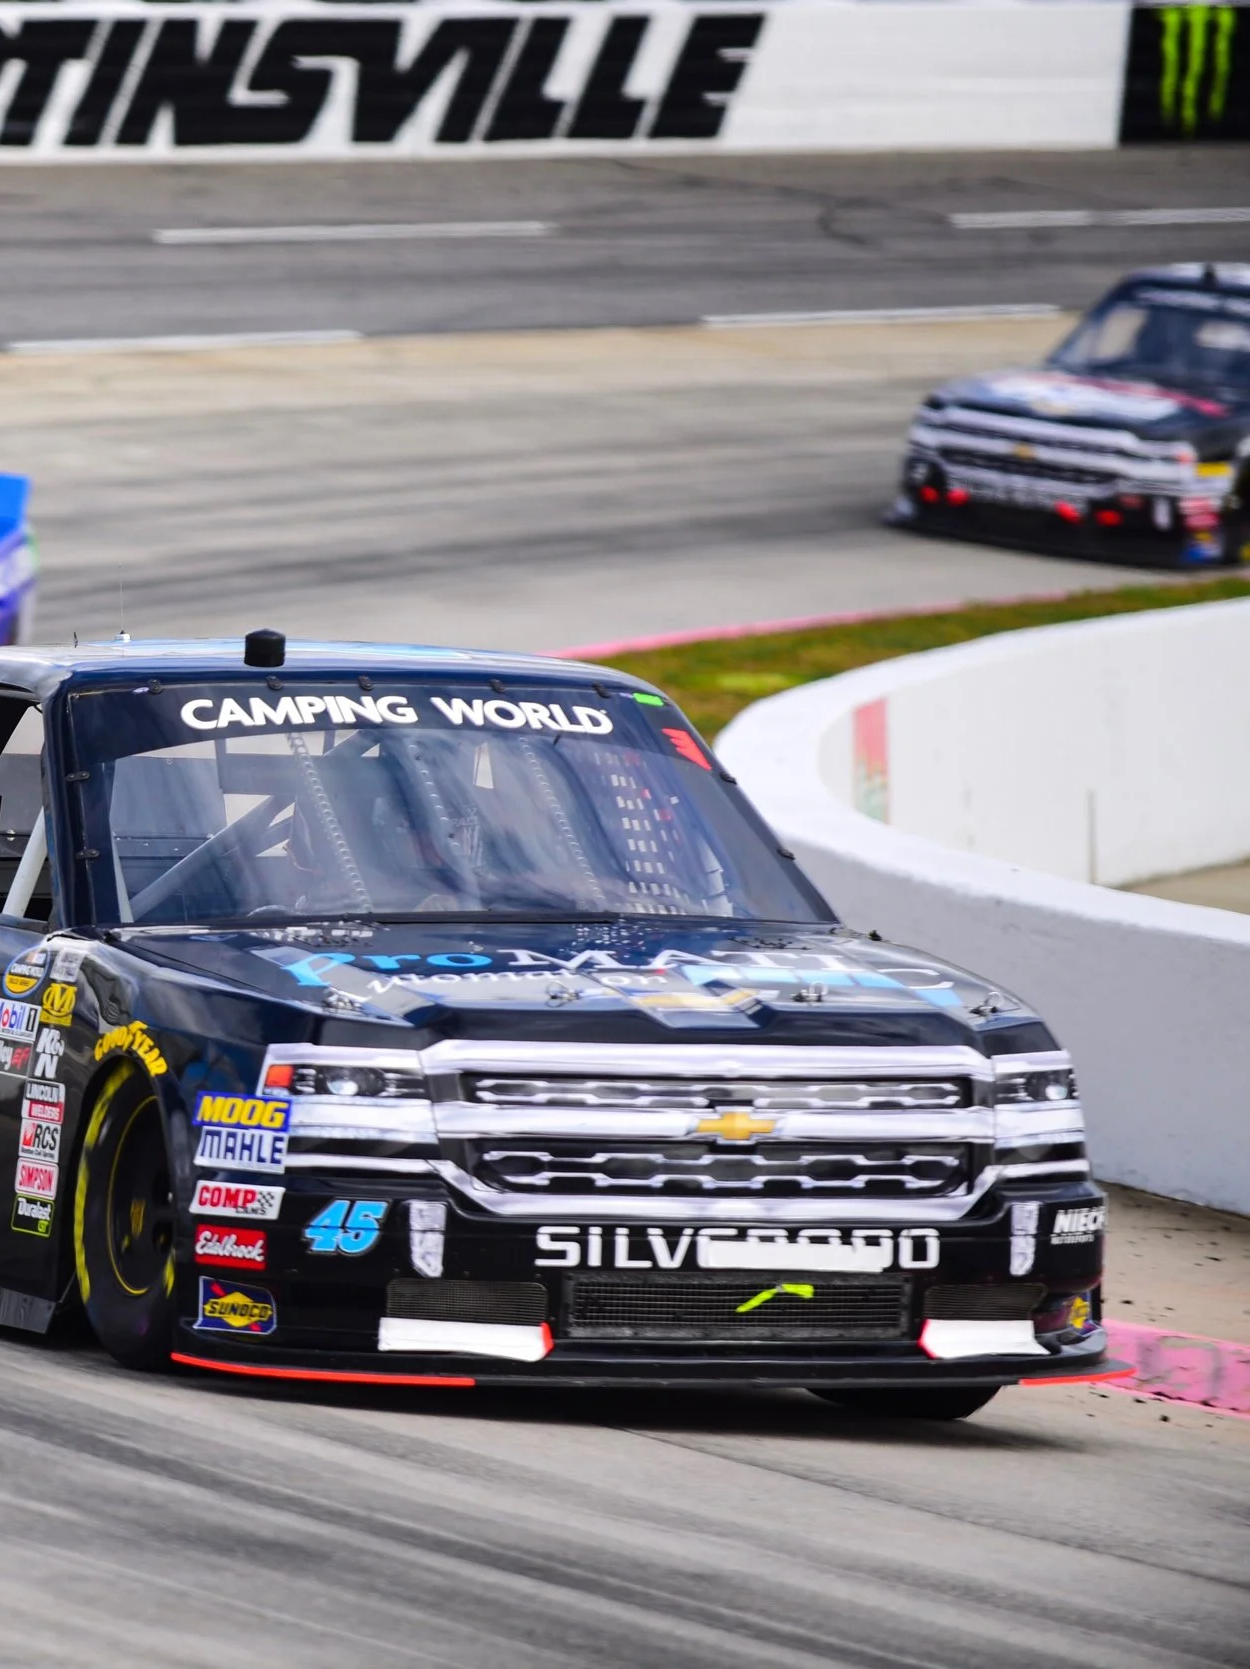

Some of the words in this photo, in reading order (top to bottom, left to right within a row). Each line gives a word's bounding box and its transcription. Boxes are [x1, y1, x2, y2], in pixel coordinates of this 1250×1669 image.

[180, 694, 419, 731] CAMPING
[429, 696, 614, 736] WORLD
[197, 1095, 289, 1128] MOOG
[33, 1124, 59, 1150] RCS
[200, 1130, 285, 1165] MAHLE
[18, 1165, 54, 1191] SIMPSON
[17, 1197, 52, 1221] Duralast
[198, 1185, 258, 1209] COMP
[304, 1198, 389, 1255] 45
[195, 1230, 266, 1263] Edelbrock
[206, 1300, 273, 1321] SUNOCO
